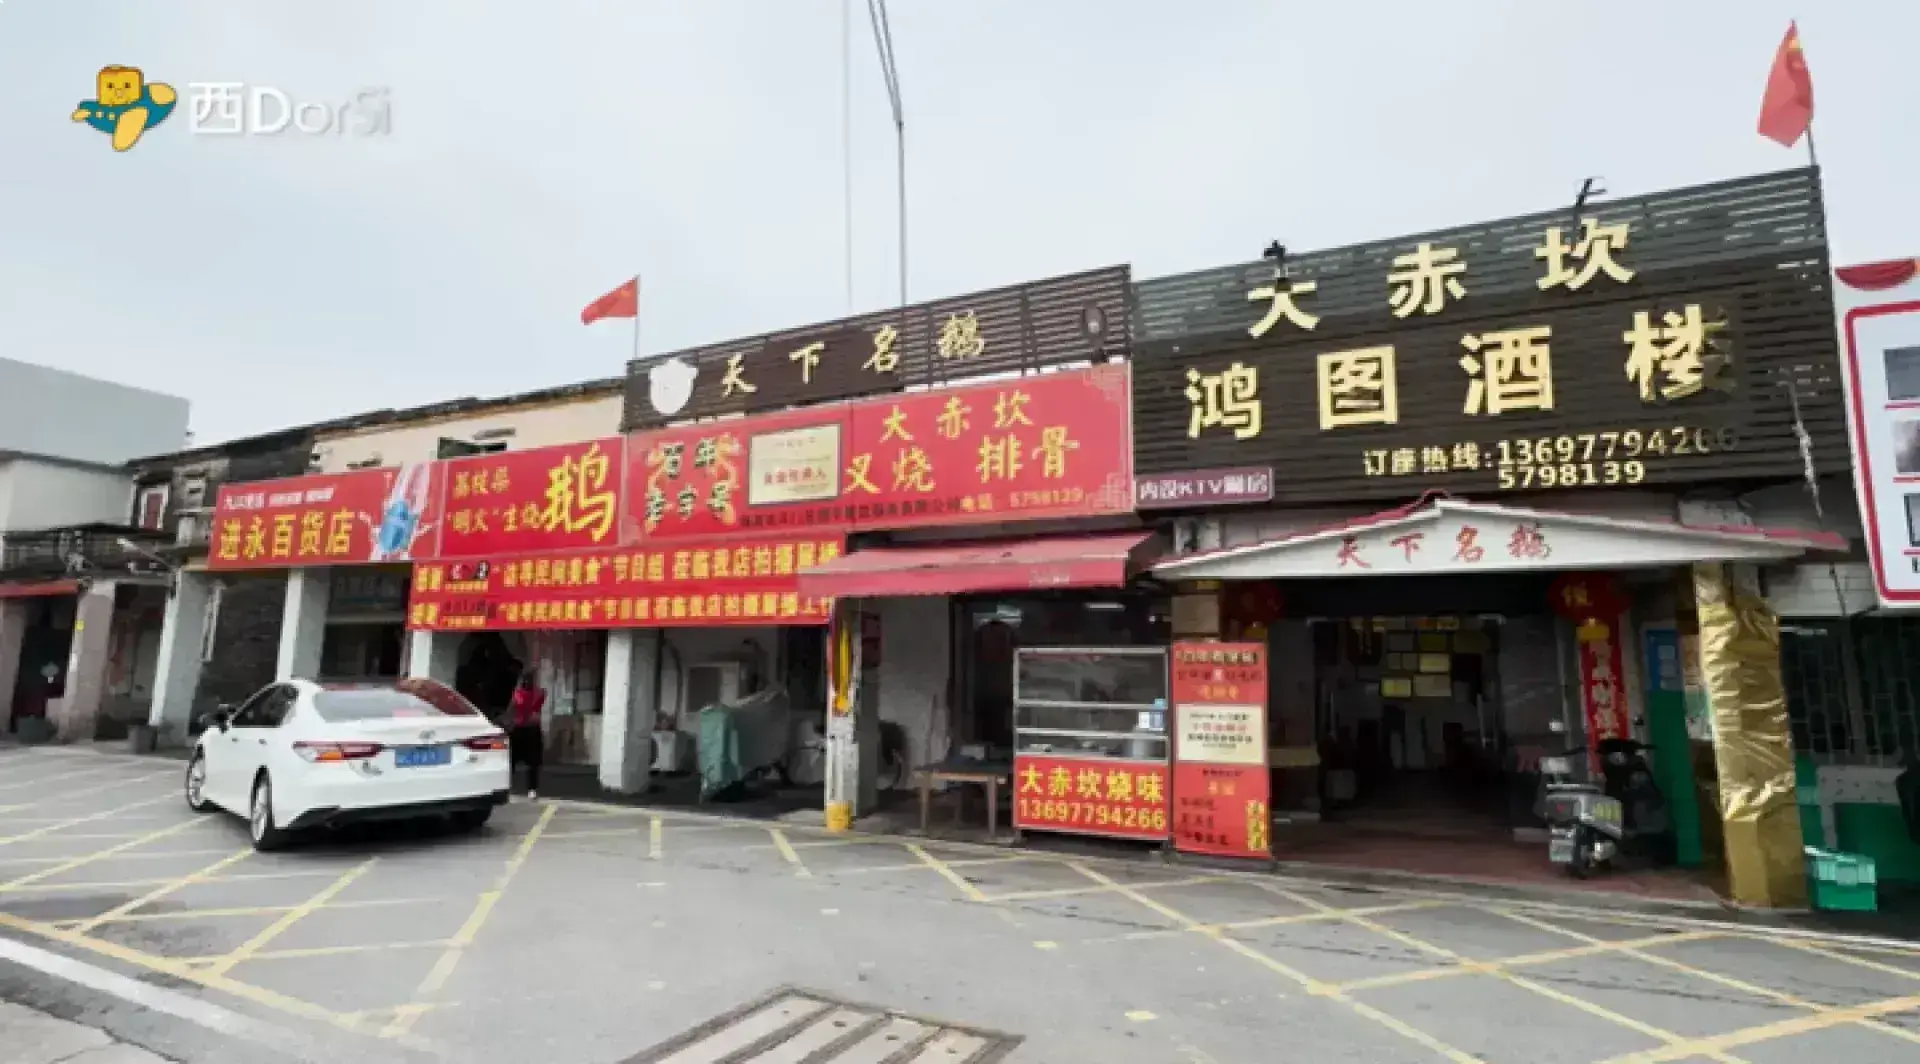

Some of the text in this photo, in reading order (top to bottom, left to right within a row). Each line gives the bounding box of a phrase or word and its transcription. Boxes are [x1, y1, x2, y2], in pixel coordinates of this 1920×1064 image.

[1246, 217, 1637, 339] 大赤坎
[880, 390, 1036, 443] 大赤坎
[542, 441, 618, 543] 鹅
[1496, 459, 1647, 490] 5798139
[1018, 797, 1167, 831] 13697794266
